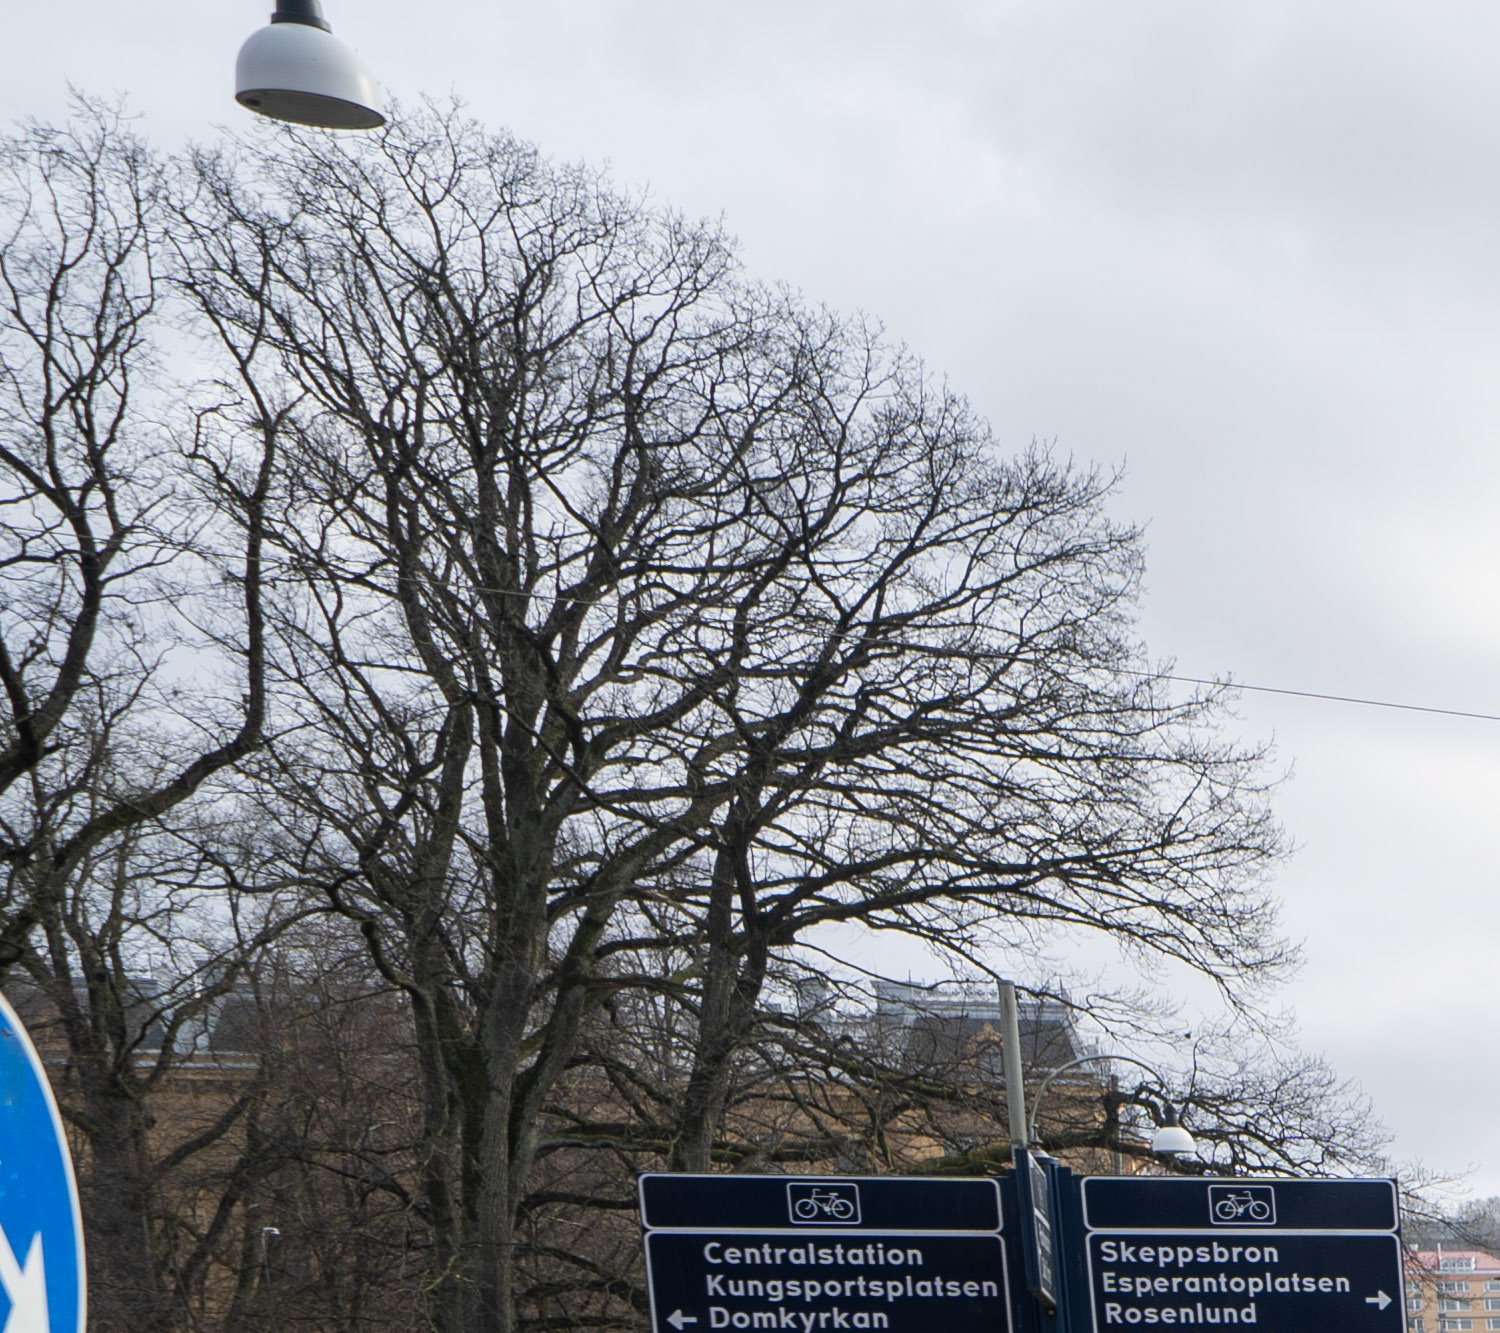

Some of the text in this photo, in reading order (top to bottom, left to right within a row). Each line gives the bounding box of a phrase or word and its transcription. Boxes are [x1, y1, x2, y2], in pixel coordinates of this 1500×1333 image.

[704, 1242, 923, 1265] Centralstation
[1101, 1241, 1279, 1267] Skeppsbron
[706, 1274, 998, 1302] Kungsportsplatsen
[1103, 1272, 1350, 1297] Esperantoplatsen
[709, 1307, 889, 1333] Domkyrkan
[1106, 1302, 1256, 1324] Rosenlund
